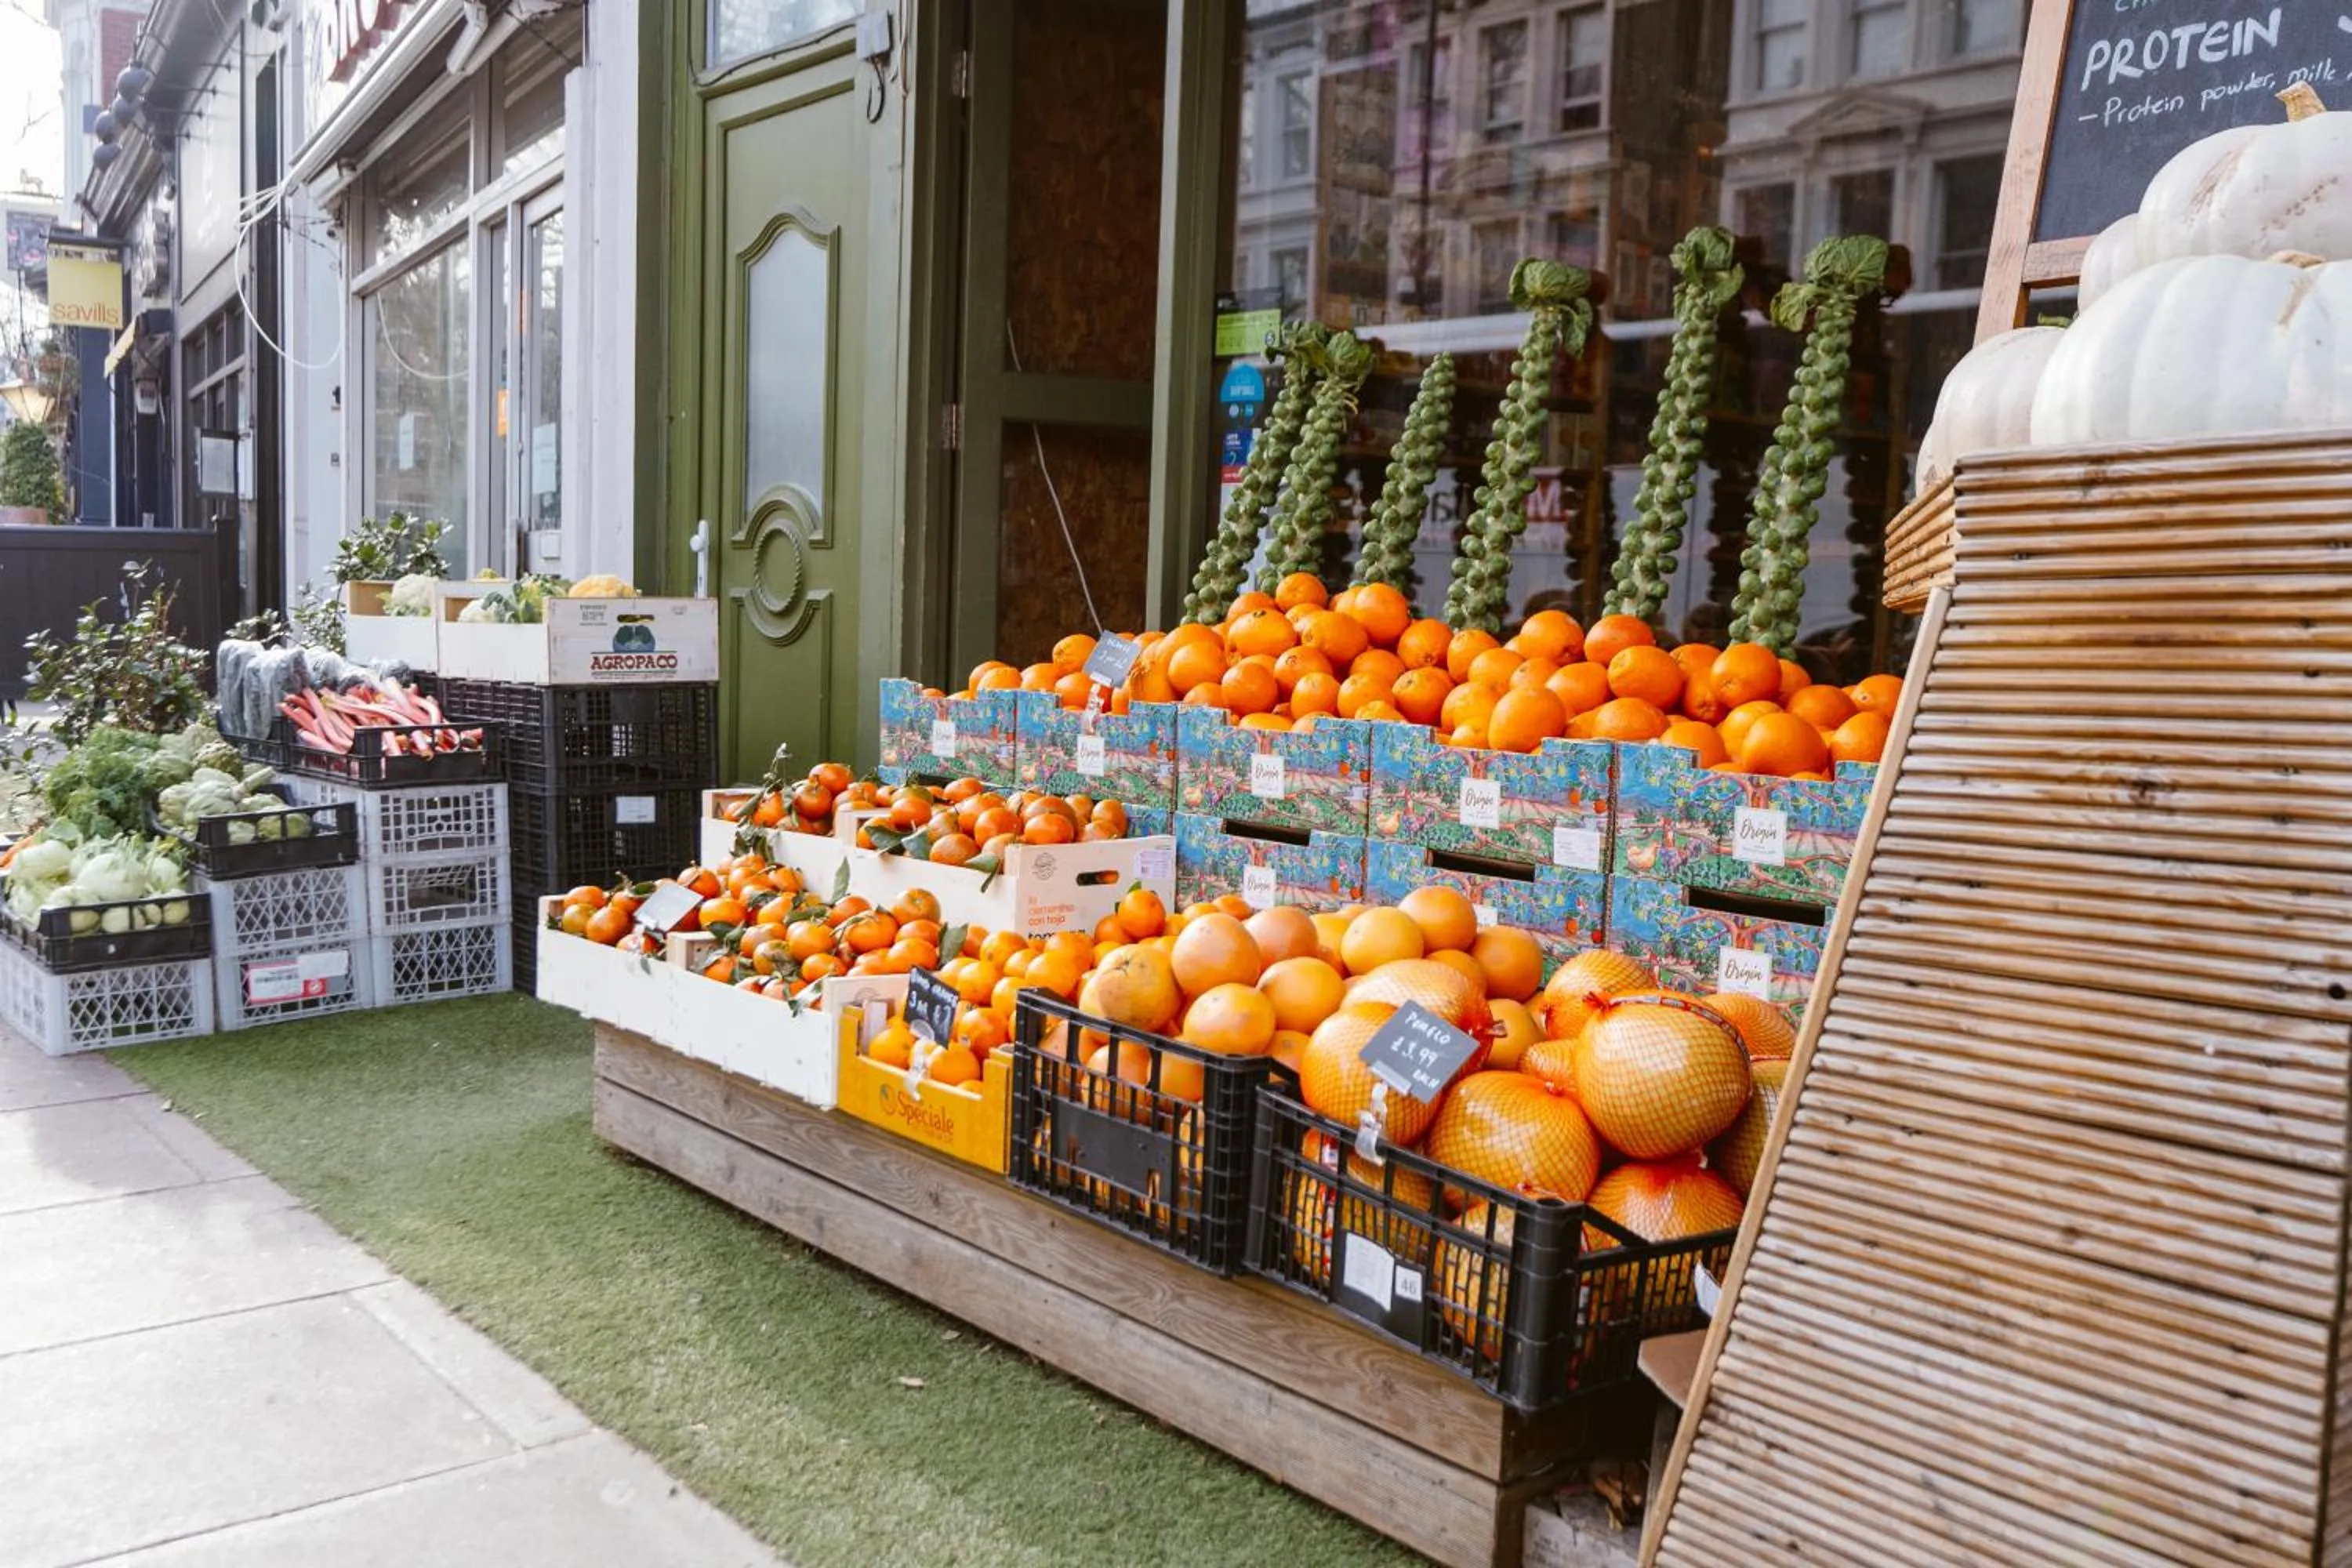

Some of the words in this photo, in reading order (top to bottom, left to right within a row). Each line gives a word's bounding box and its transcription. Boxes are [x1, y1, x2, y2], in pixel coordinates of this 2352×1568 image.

[2081, 8, 2281, 92] PROTEIN
[2201, 72, 2275, 112] powder,
[2288, 57, 2336, 84] milk
[53, 301, 118, 325] savills
[590, 654, 678, 670] AGROPACO
[1740, 817, 1777, 844] Origin
[1725, 959, 1762, 985] Origin
[898, 1091, 954, 1135] Speciale
